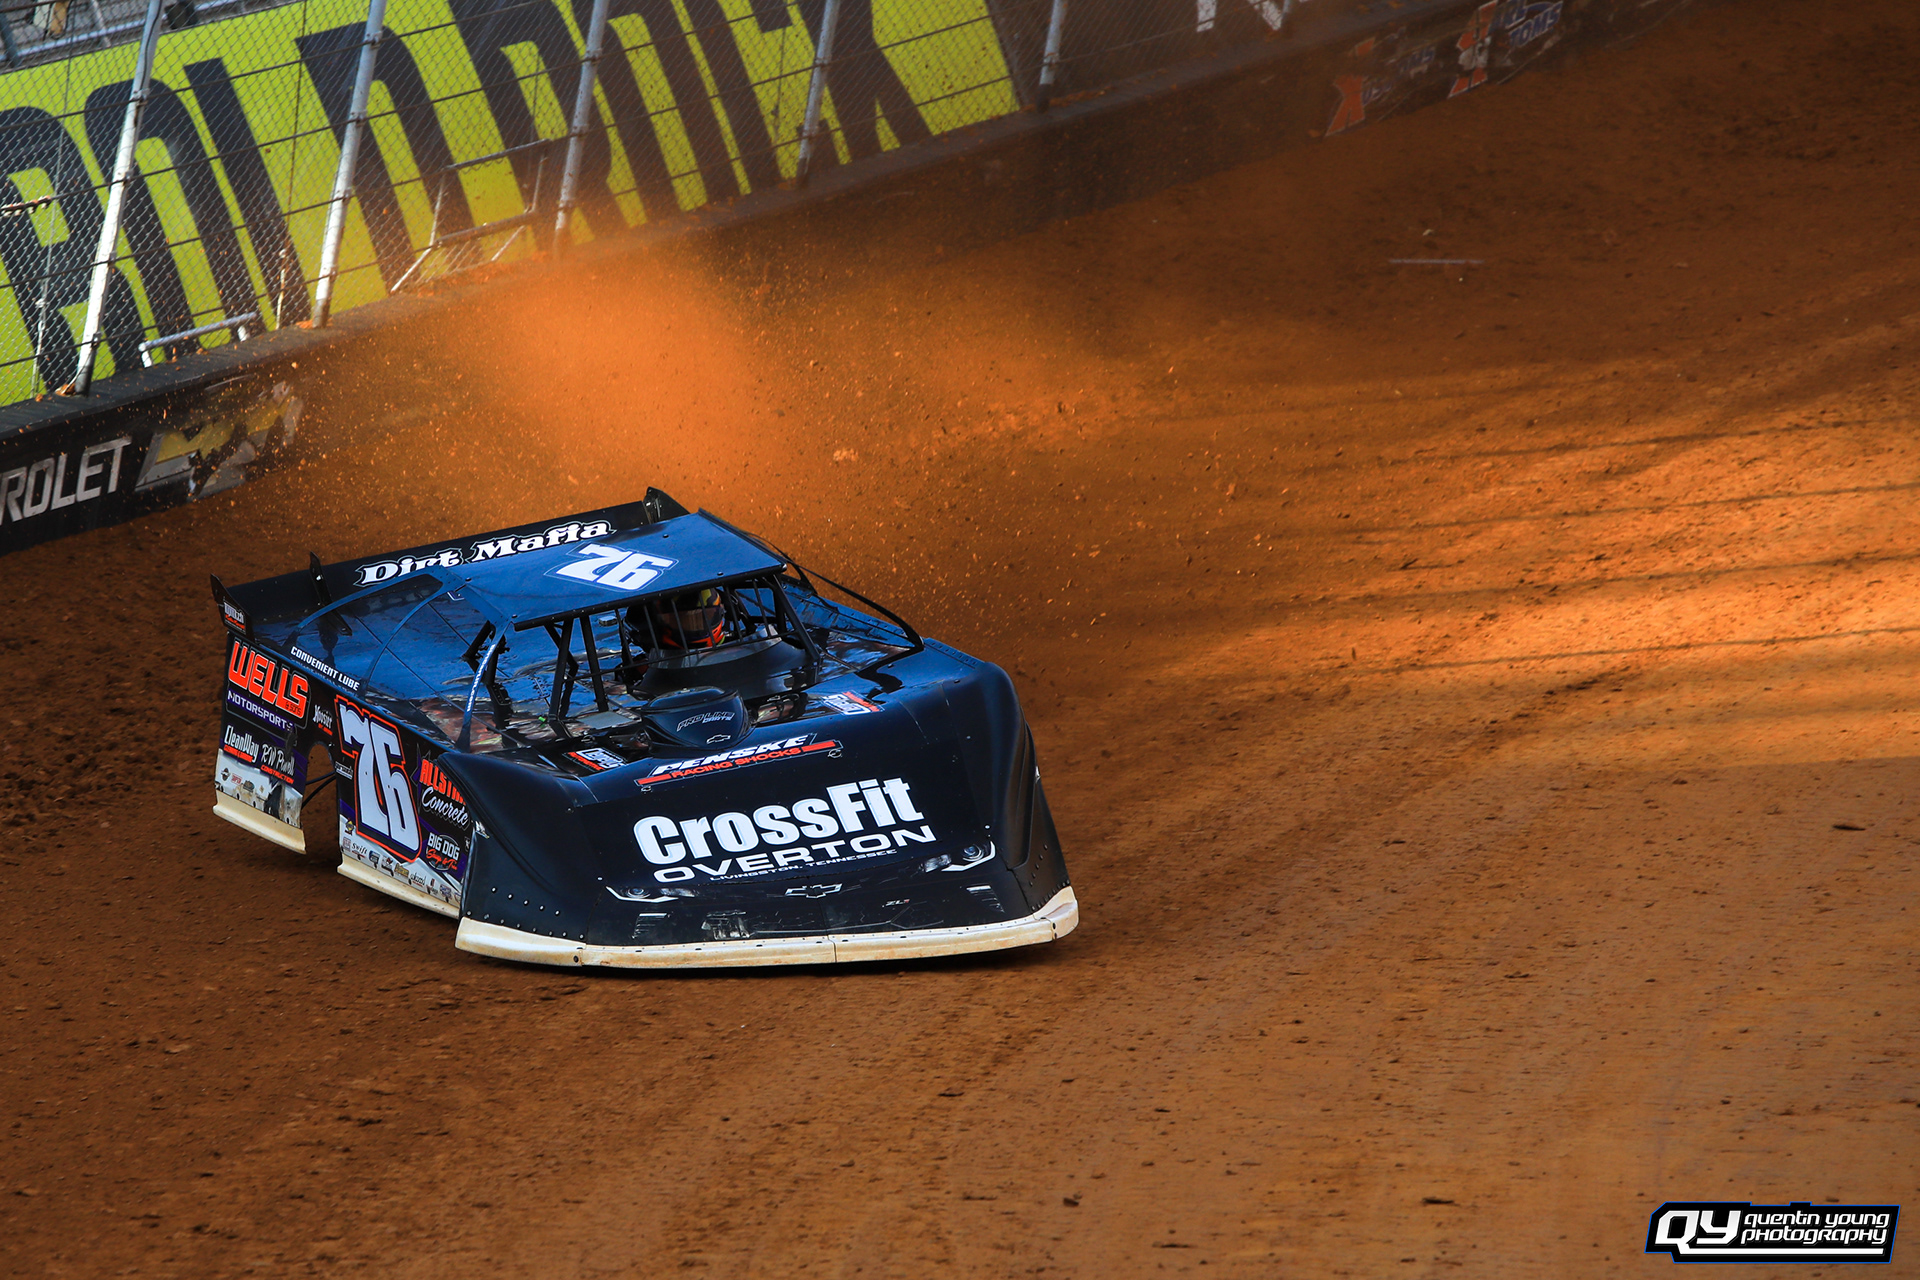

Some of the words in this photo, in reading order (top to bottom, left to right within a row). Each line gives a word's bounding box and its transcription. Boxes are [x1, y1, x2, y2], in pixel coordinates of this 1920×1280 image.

[358, 550, 462, 586] Dirt
[469, 520, 614, 563] Mafia
[556, 542, 675, 591] 76
[228, 640, 309, 719] WELLS
[290, 646, 338, 679] CONVENIENT
[338, 673, 360, 691] LUBE
[339, 703, 420, 851] 76
[653, 734, 809, 776] PENSKE
[671, 760, 733, 779] RACING
[735, 747, 802, 766] SHOCKS
[421, 786, 468, 826] Concrete
[633, 778, 924, 865] CrossFit
[428, 832, 443, 852] BIG
[442, 840, 461, 861] DOG
[653, 825, 937, 883] OVERTON
[808, 849, 898, 868] TENNESSEE
